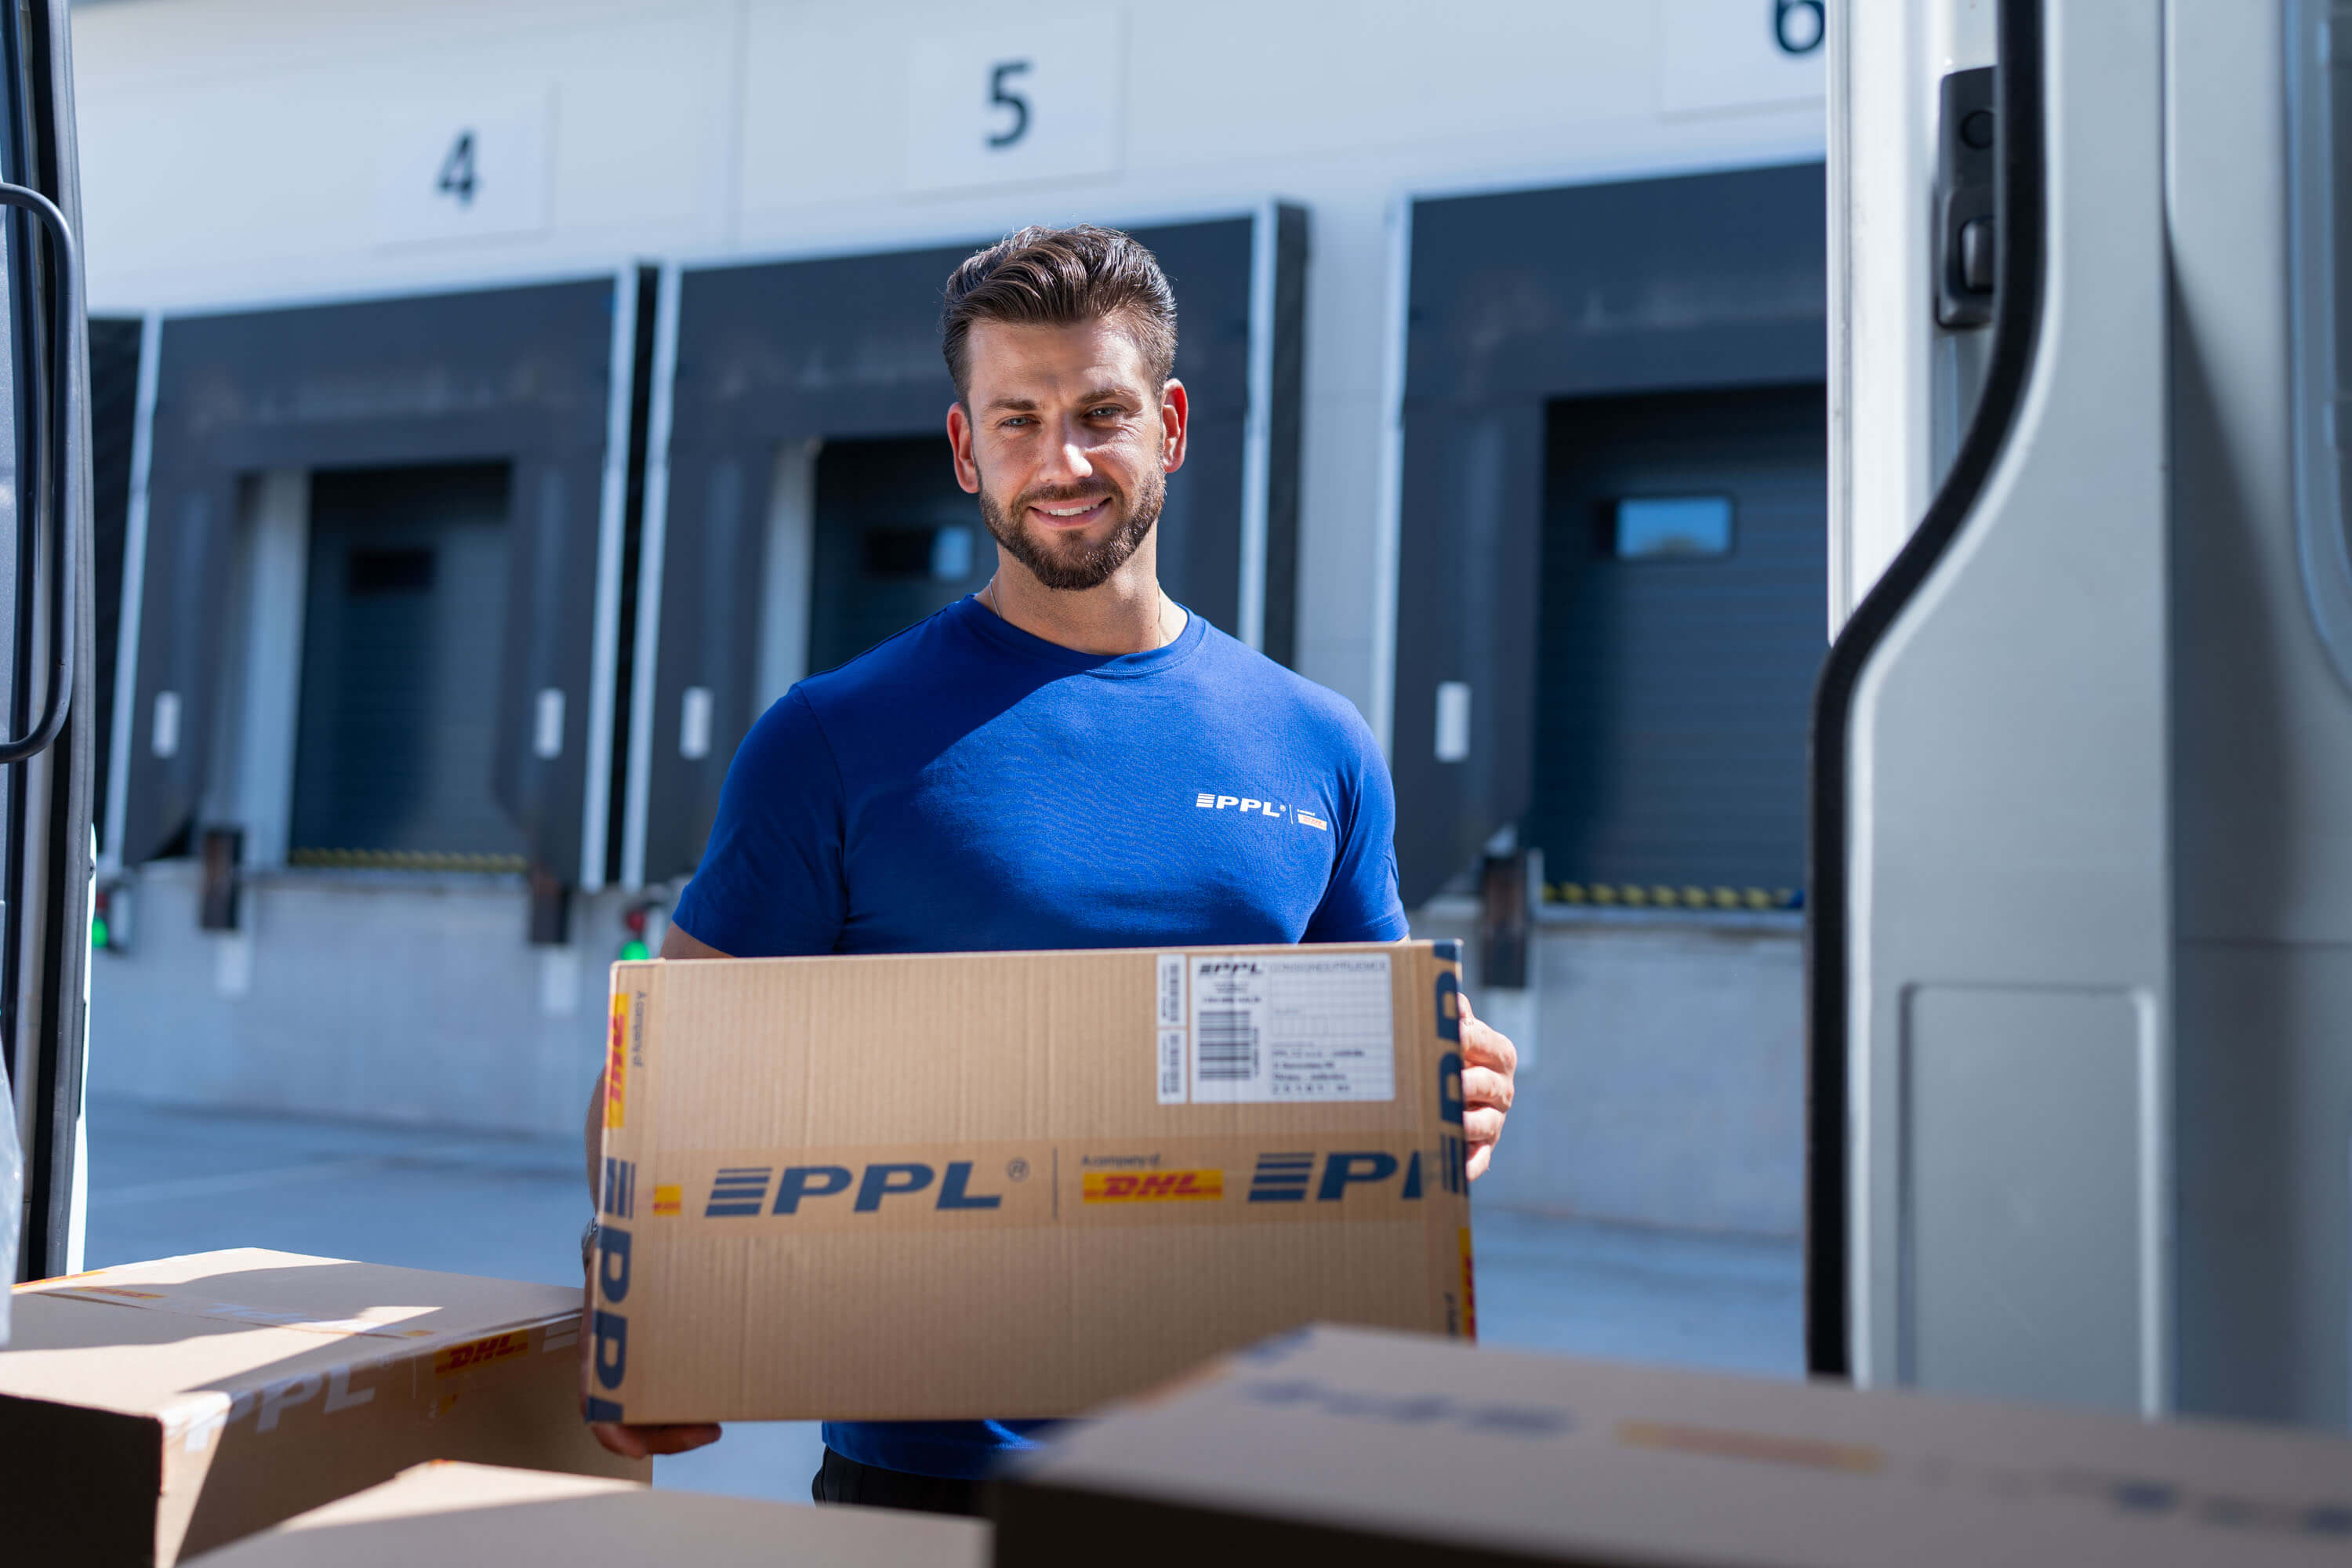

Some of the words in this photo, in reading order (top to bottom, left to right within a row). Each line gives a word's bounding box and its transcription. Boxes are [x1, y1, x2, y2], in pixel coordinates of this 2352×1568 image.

[984, 60, 1033, 149] 5
[436, 128, 481, 209] 4
[1216, 795, 1280, 818] PPL
[1094, 1154, 1146, 1168] company
[1104, 1172, 1202, 1197] DHL
[448, 1333, 519, 1370] DHL
